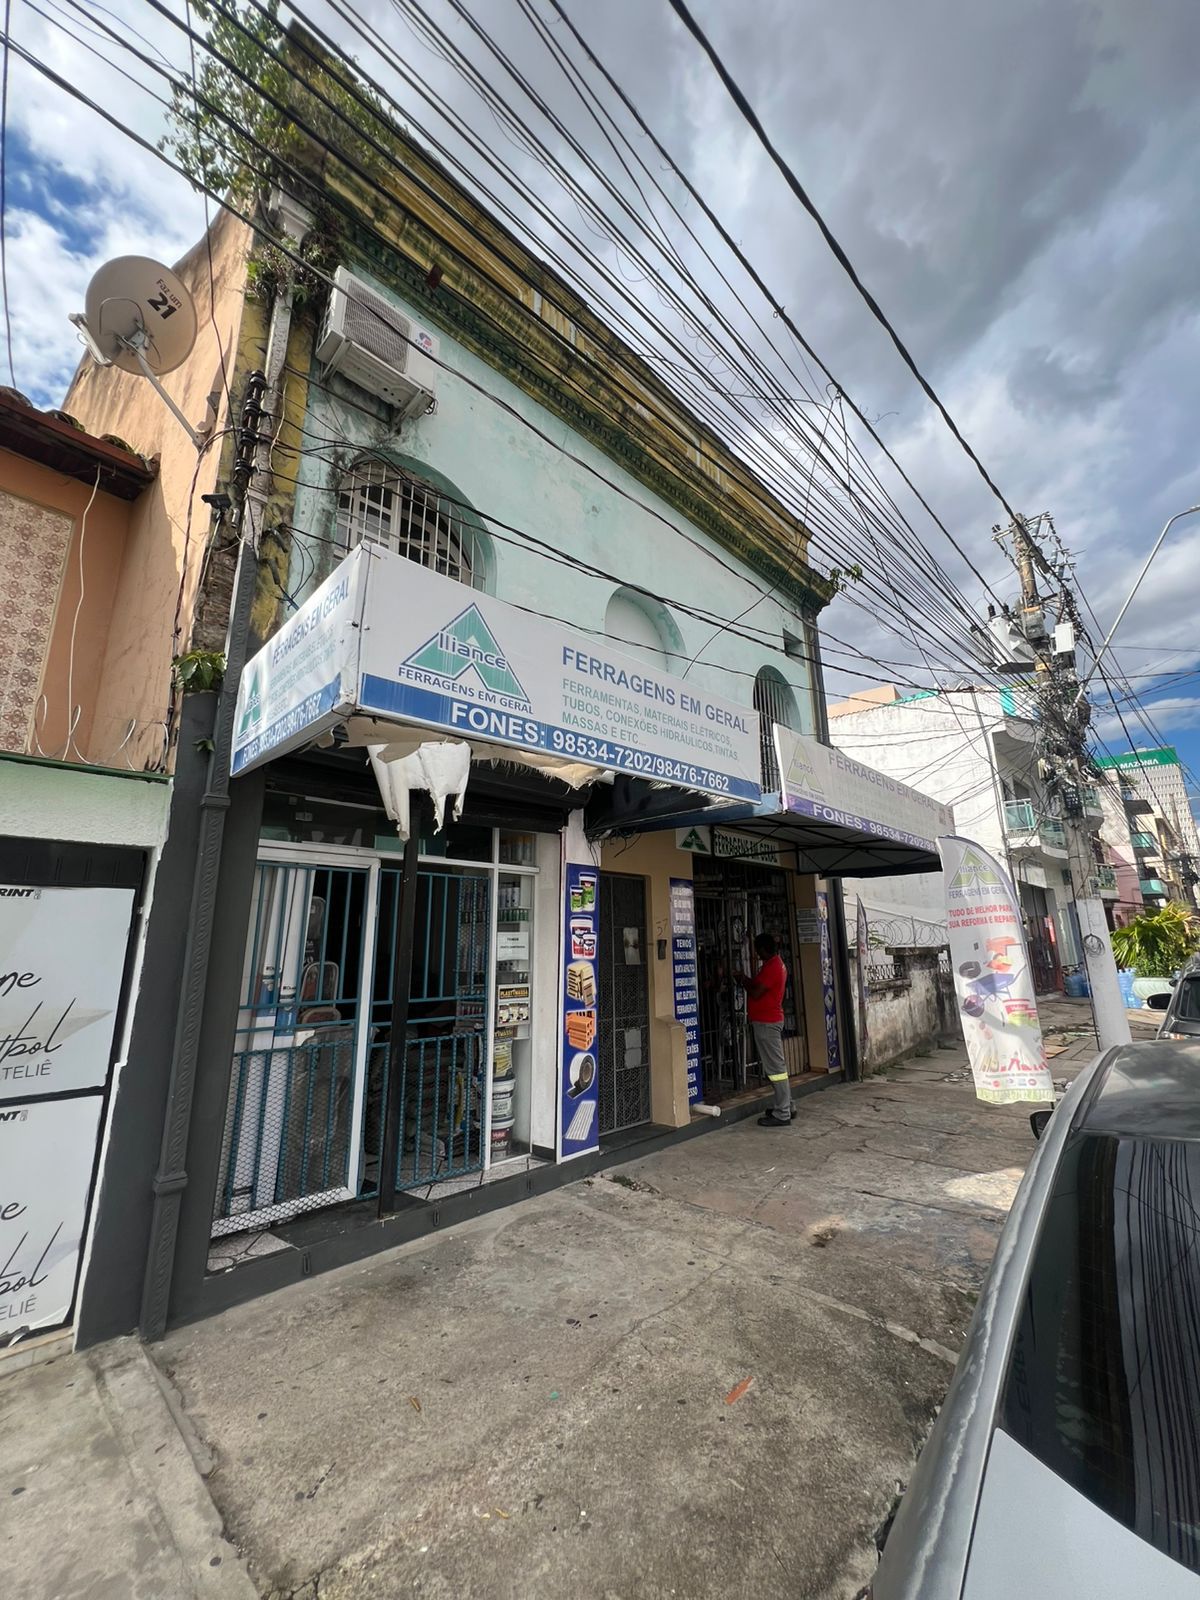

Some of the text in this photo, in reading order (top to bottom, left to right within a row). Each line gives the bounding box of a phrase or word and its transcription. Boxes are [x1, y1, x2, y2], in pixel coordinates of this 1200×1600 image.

[156, 278, 170, 295] Faz
[147, 292, 177, 319] 21
[398, 667, 534, 715] FERRAGENS EM GERAL
[562, 646, 749, 734] FERRAGENS EM GERAL
[563, 678, 642, 716] FERRAMENTAS,
[644, 707, 688, 730] MATERIAIS
[562, 694, 603, 719] TUBOS,
[606, 707, 658, 735] CONEXÕES
[562, 712, 607, 738] MASSAS
[611, 728, 618, 739] E
[452, 702, 729, 791] FONES: 98534-7202/98476-7662
[829, 752, 937, 811] FERRAGENS EM GERAL
[813, 804, 867, 831] FONES:
[949, 908, 965, 917] TUDO
[966, 907, 975, 915] DE
[949, 920, 960, 929] SUA
[961, 917, 988, 927] REFORMA
